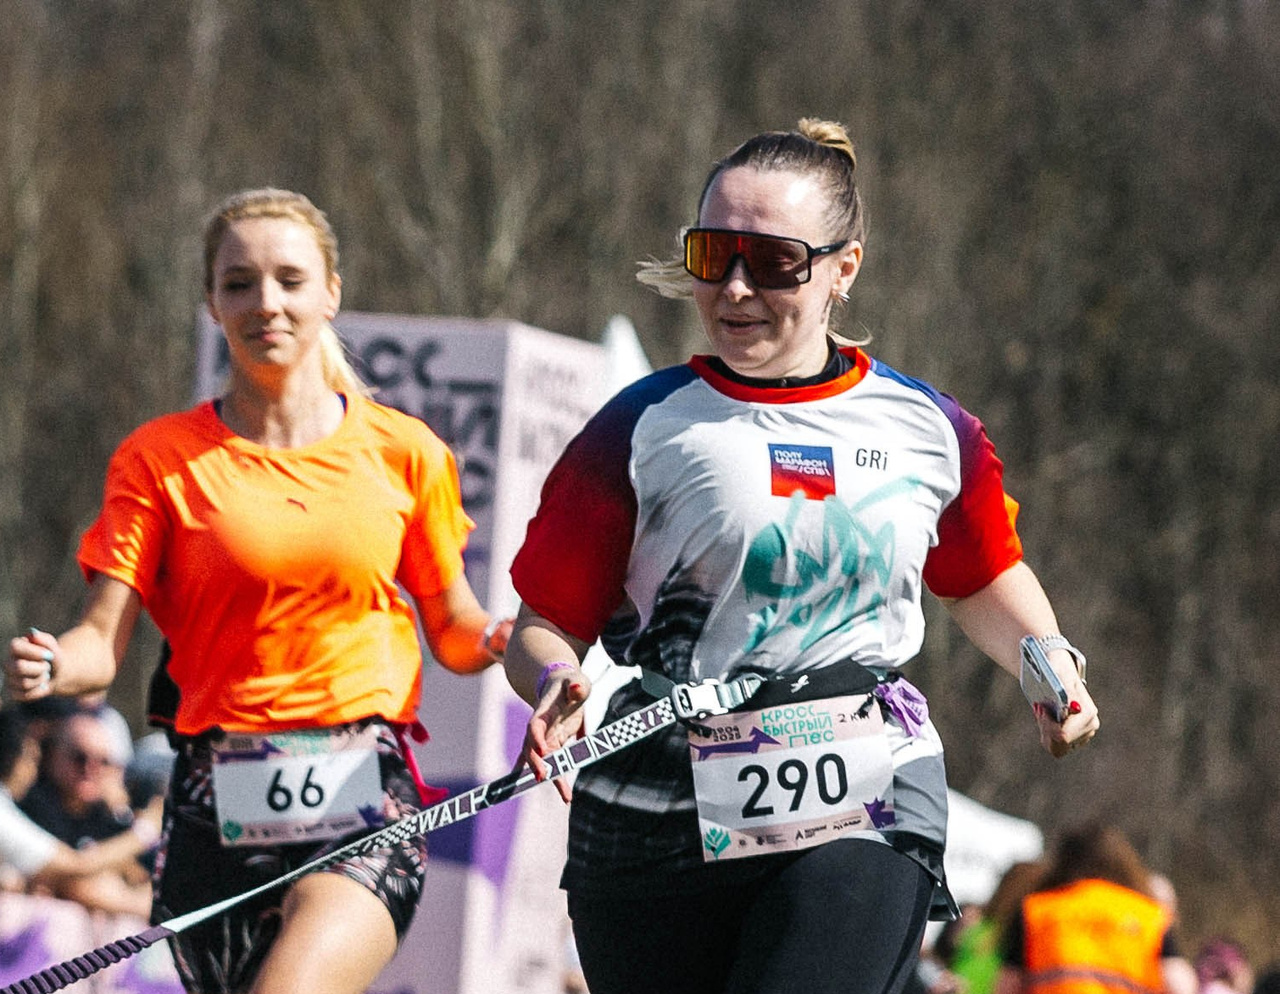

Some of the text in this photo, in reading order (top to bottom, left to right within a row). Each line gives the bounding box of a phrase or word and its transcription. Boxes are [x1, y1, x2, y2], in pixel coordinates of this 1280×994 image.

[855, 448, 888, 471] GRi
[838, 713, 847, 723] 2
[267, 766, 324, 812] 66
[737, 753, 848, 818] 290
